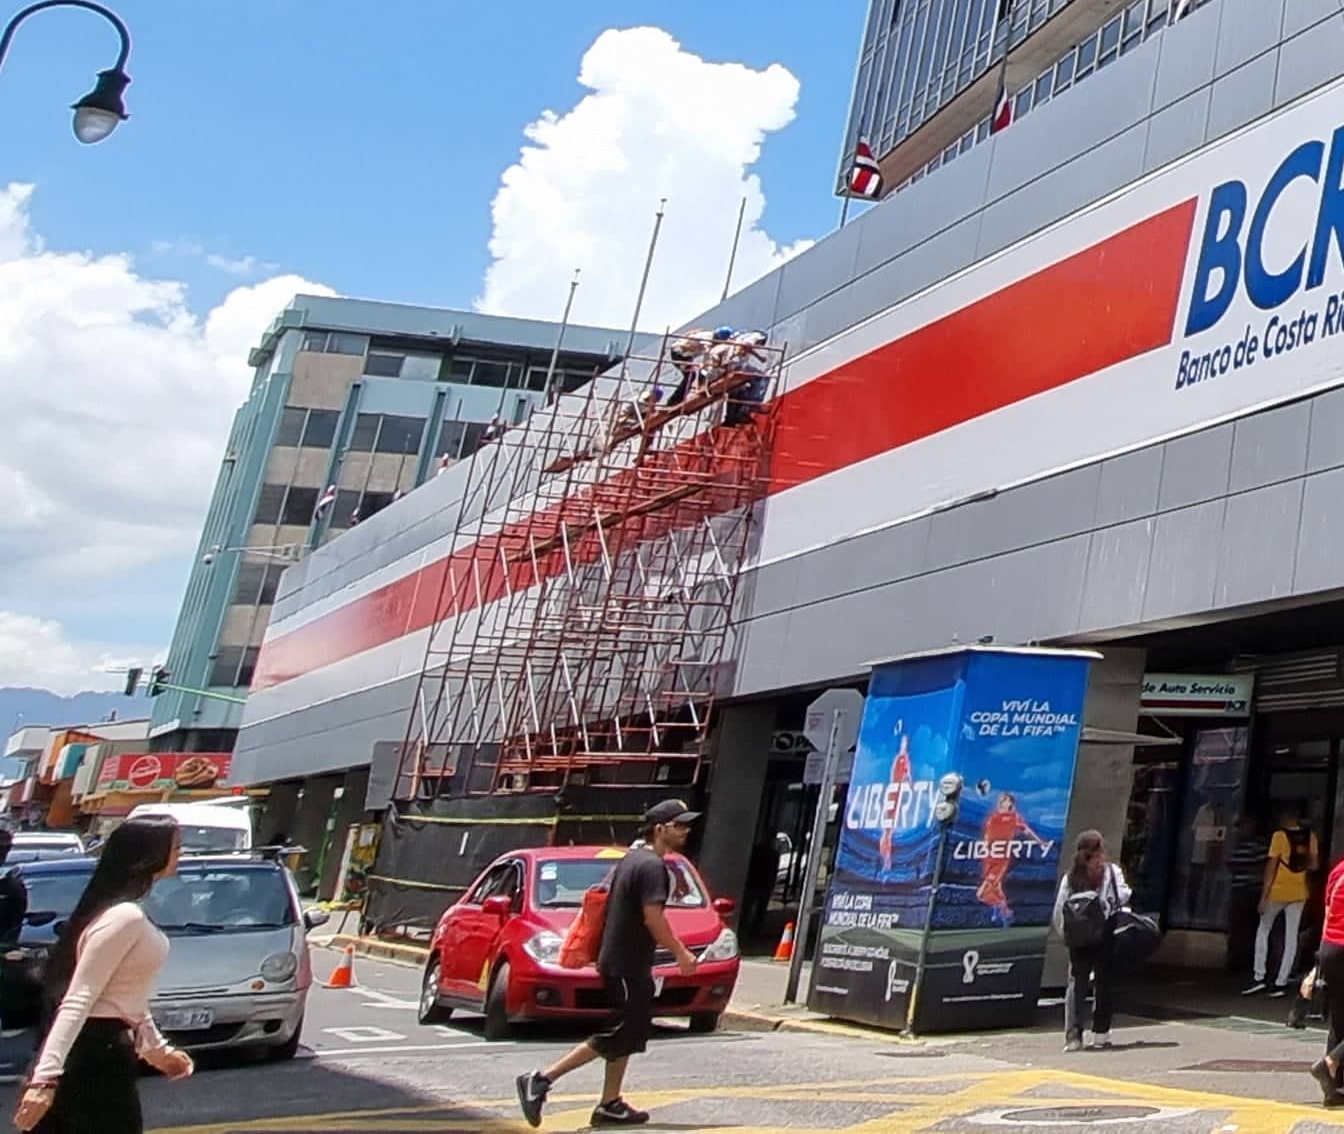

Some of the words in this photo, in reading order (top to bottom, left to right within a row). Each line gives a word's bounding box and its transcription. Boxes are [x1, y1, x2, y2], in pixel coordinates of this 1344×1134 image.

[1175, 350, 1232, 390] Banco
[1234, 324, 1259, 370] de
[1263, 310, 1319, 359] Costa
[1160, 683, 1187, 694] Auto
[1190, 682, 1236, 695] Servicio
[1002, 698, 1033, 712] VIVÍ
[1032, 700, 1050, 712] LA
[970, 712, 1008, 723] COPA
[1012, 713, 1077, 725] MUNDIAL
[979, 725, 1000, 736] DE
[1001, 725, 1020, 736] LA
[846, 780, 941, 829] LIBERTY
[953, 840, 1055, 859] LIBERTY
